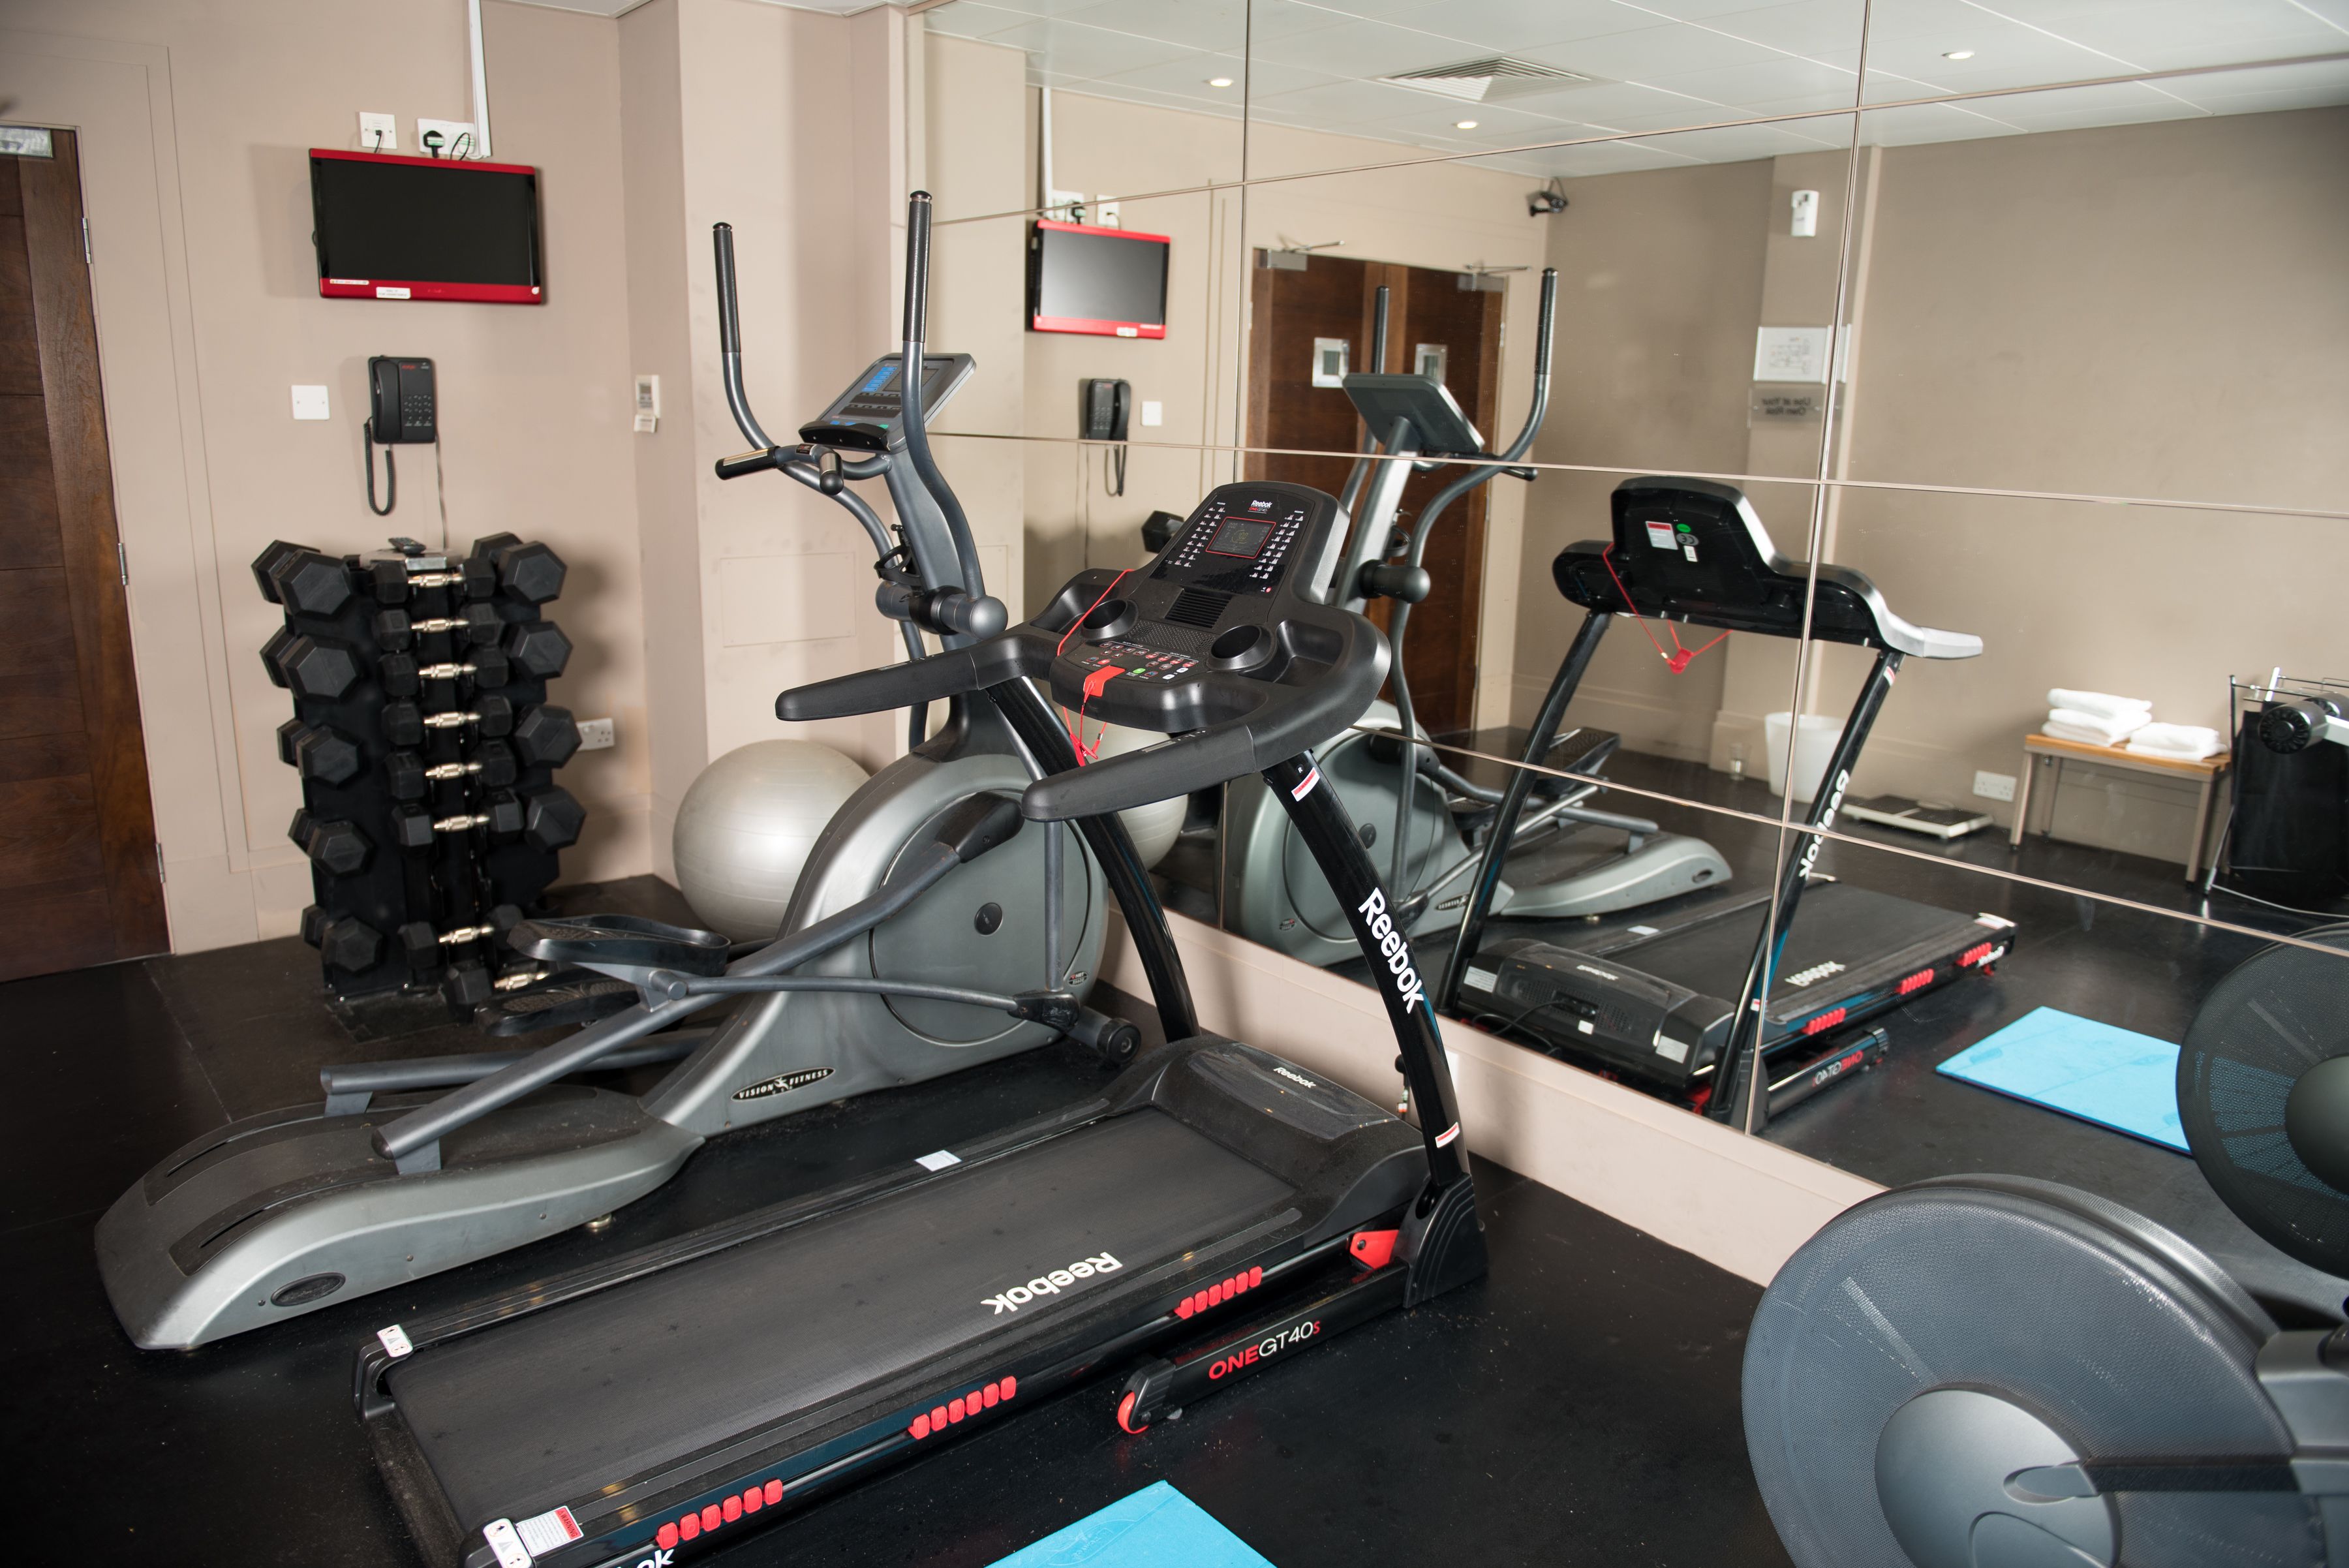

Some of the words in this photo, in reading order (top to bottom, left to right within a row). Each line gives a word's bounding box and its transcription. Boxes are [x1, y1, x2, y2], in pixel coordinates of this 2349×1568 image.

[1251, 500, 1272, 508] Reebok
[1358, 887, 1424, 1014] Reebok
[739, 1083, 774, 1099] VISION
[789, 1069, 829, 1086] FITNESS
[1274, 1067, 1317, 1089] Reebok
[981, 1252, 1124, 1315] Reebok
[560, 1512, 578, 1538] WARNING
